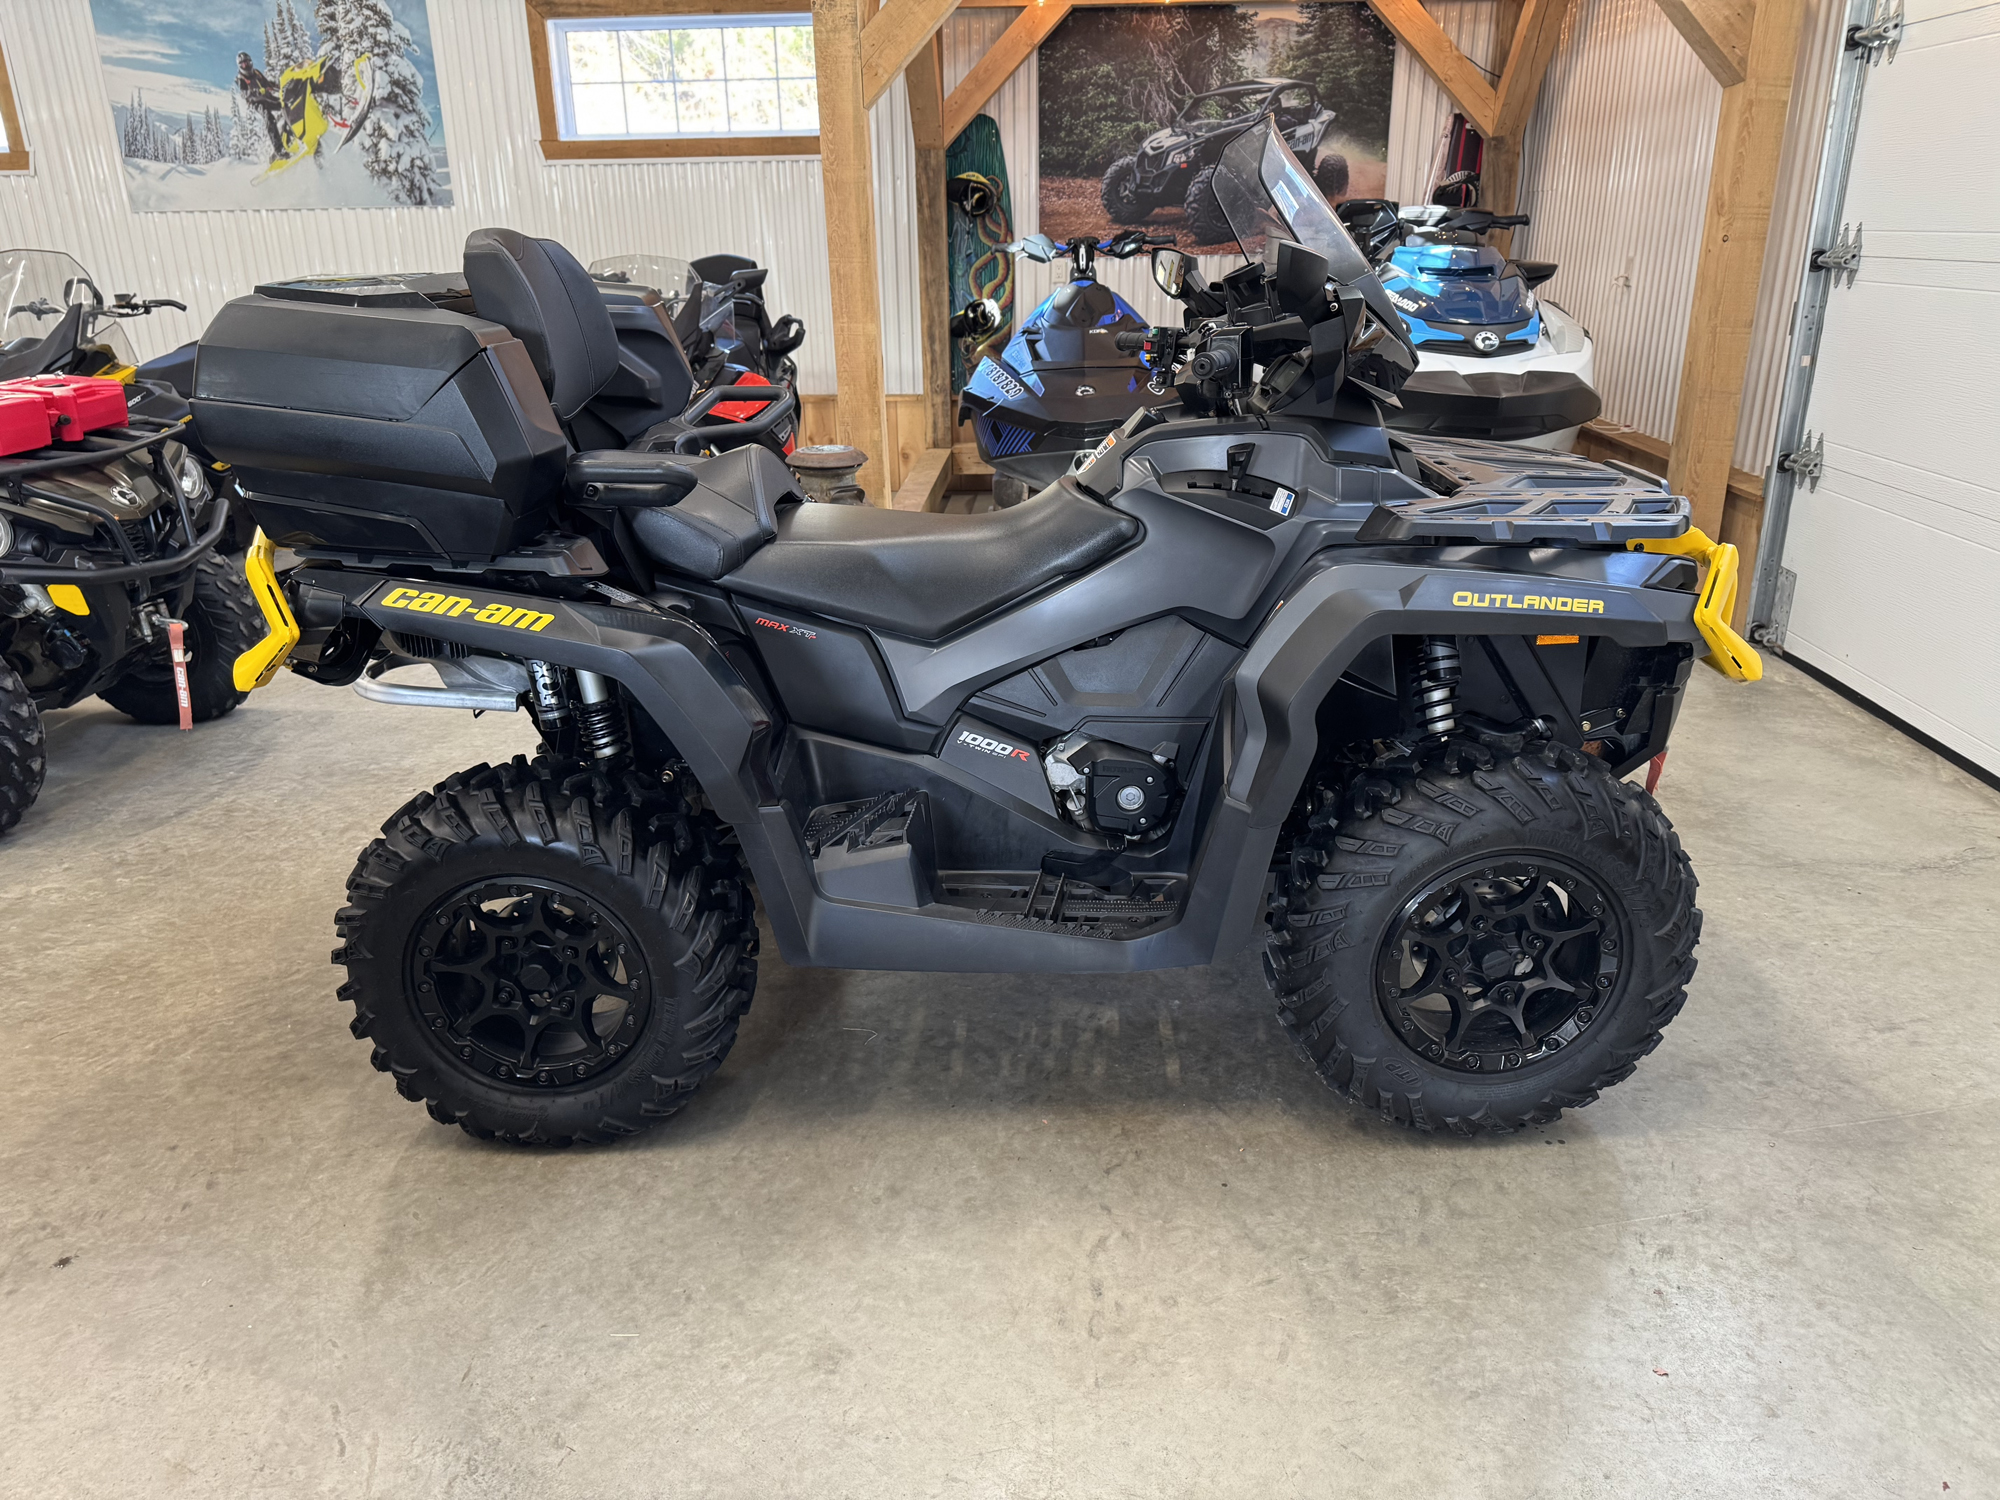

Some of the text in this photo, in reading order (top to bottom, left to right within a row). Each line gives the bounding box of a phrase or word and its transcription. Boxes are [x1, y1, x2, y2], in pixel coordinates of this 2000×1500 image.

[380, 587, 556, 632] can-am
[1452, 591, 1605, 614] OUTLANDER
[755, 617, 790, 632] MAX
[176, 666, 189, 708] can-am
[530, 660, 561, 707] FOX
[958, 730, 1031, 762] 1000R
[1384, 1062, 1419, 1084] ITP
